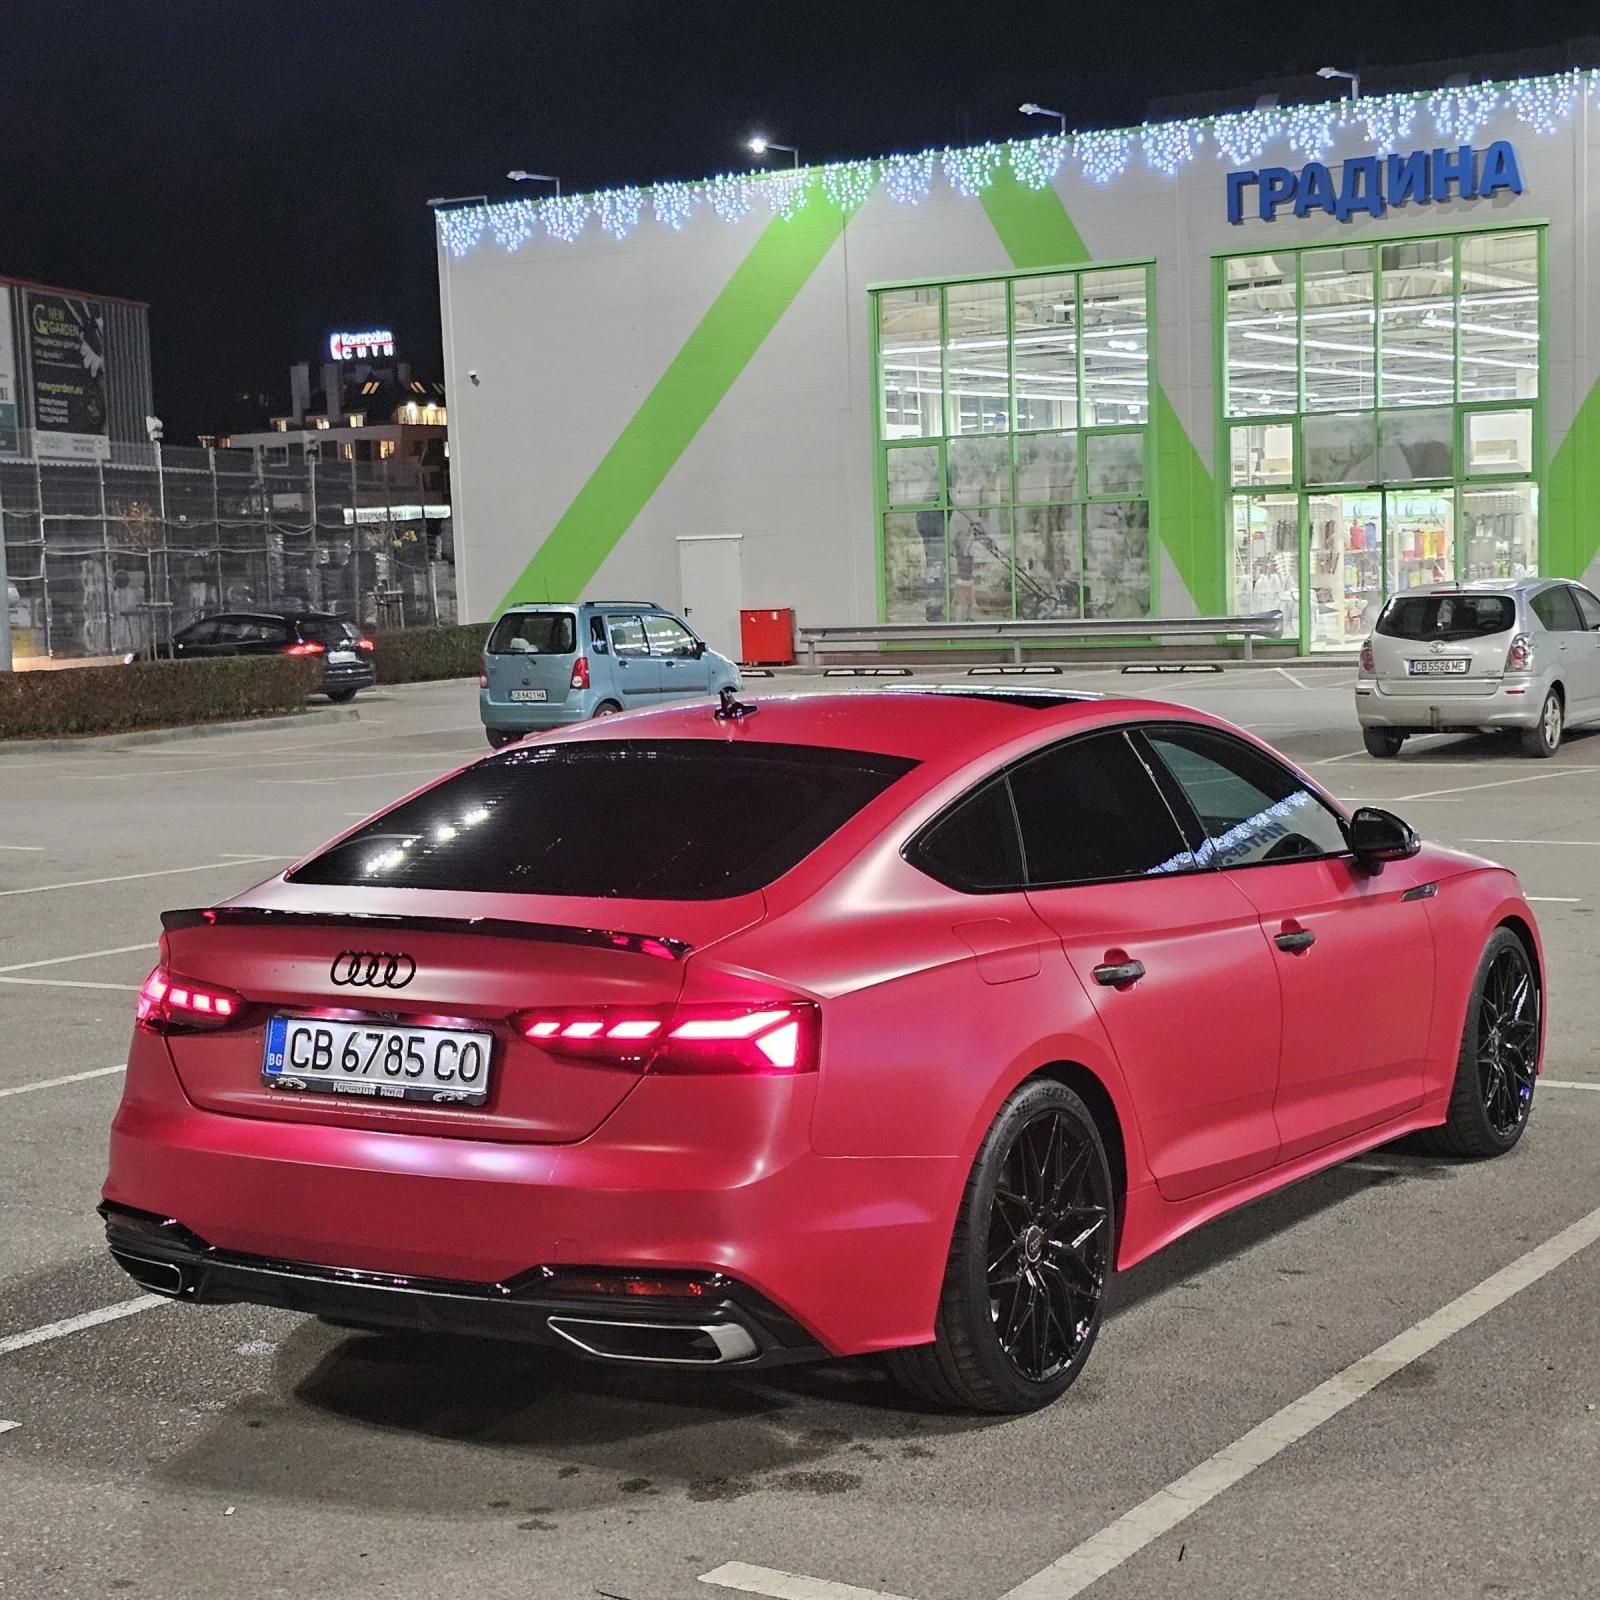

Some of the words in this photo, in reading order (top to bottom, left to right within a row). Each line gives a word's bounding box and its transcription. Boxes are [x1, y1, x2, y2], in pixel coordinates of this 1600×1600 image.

[1227, 141, 1524, 224] ГРАДИНА
[1428, 662, 1450, 671] 5526
[1451, 661, 1464, 671] ME
[268, 1053, 283, 1066] BG
[290, 1028, 333, 1070] CB
[341, 1031, 425, 1078] 6785
[434, 1039, 481, 1083] CO
